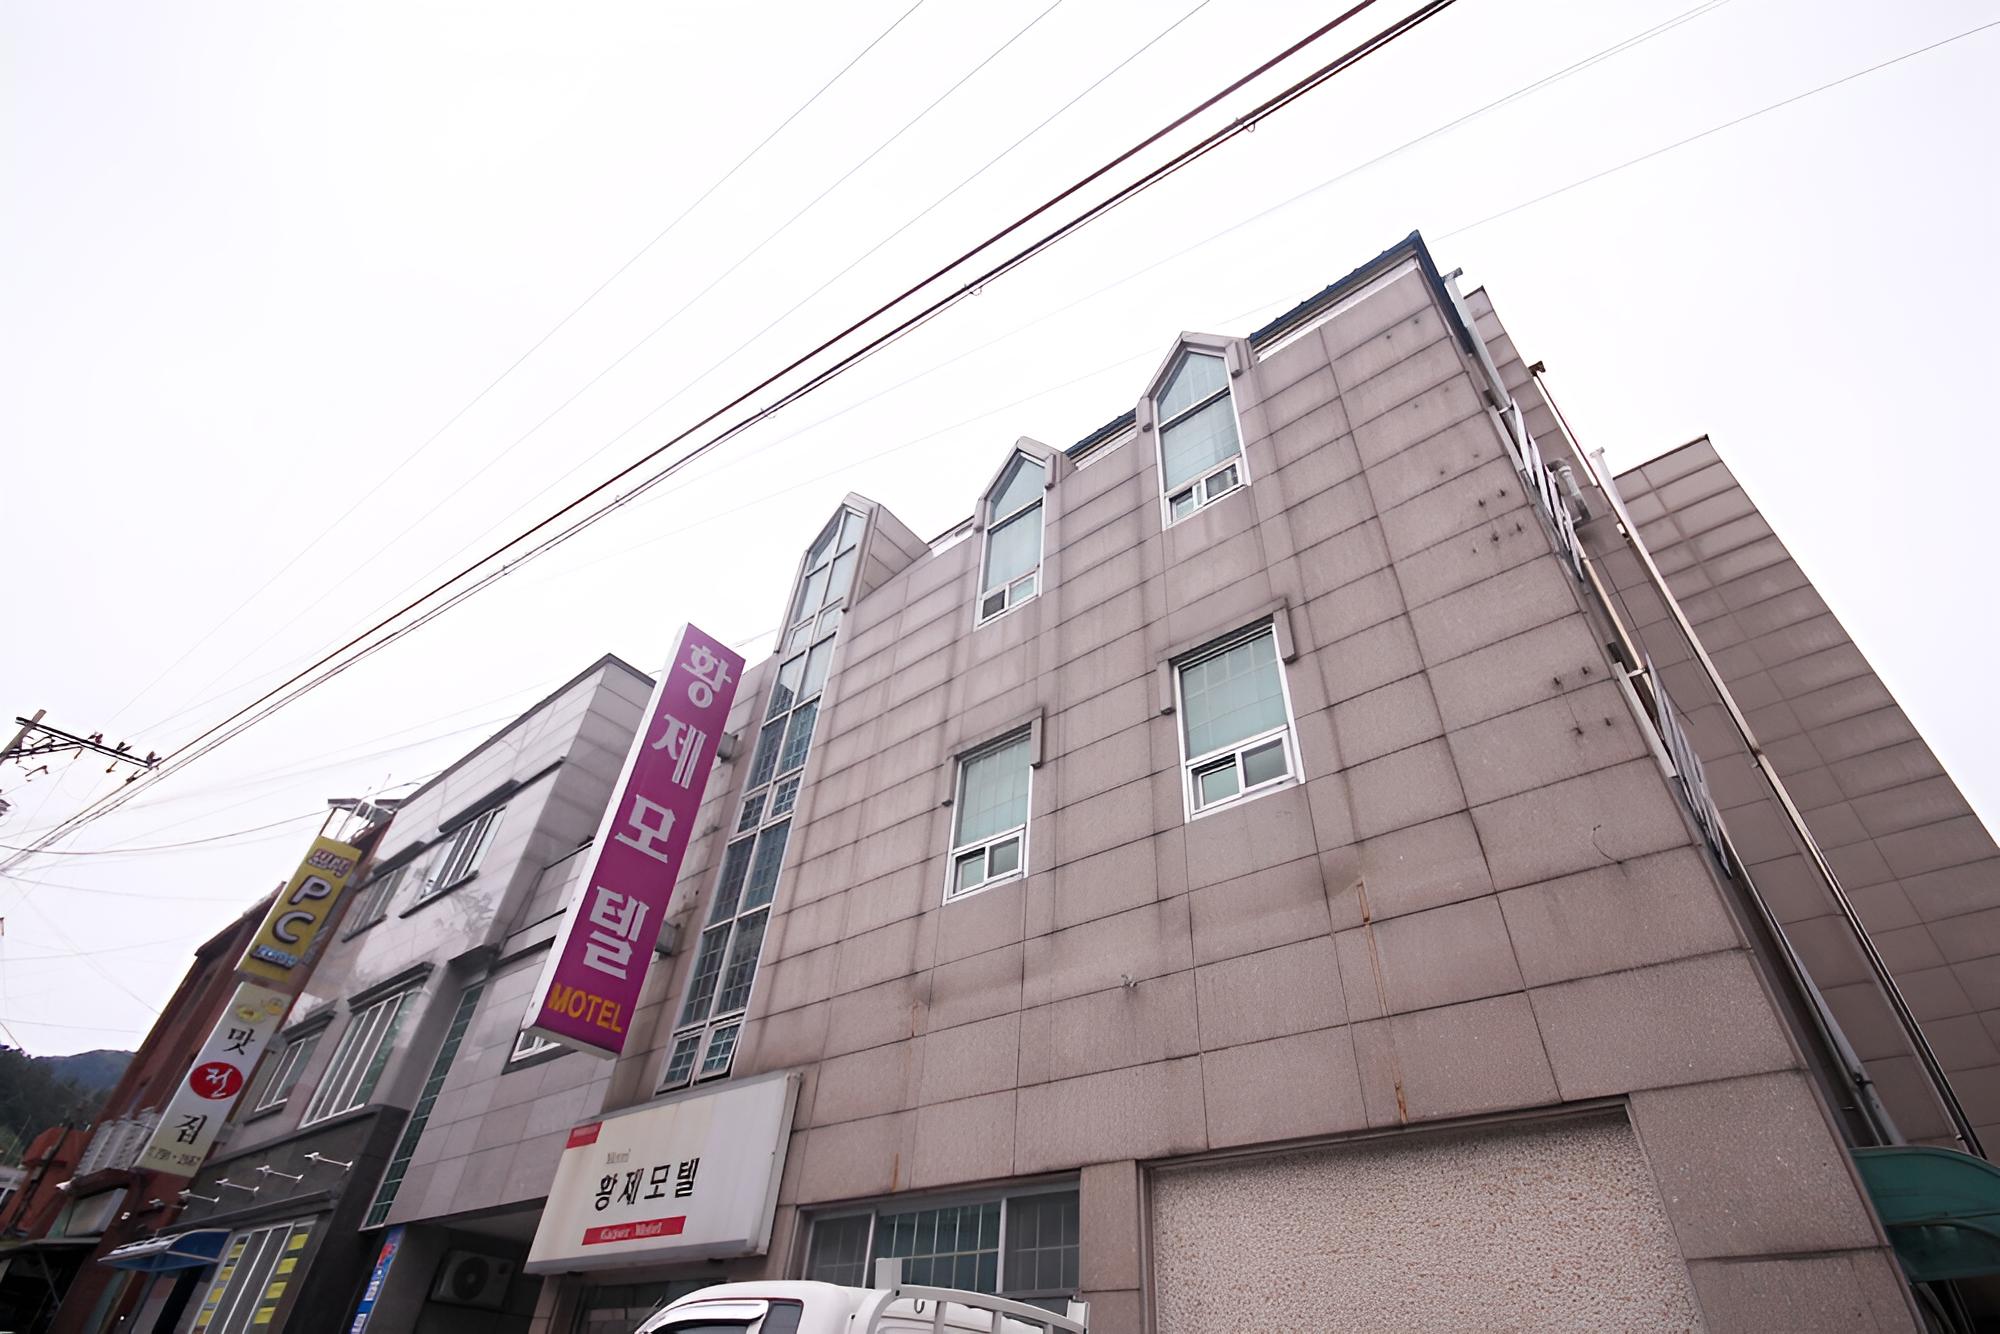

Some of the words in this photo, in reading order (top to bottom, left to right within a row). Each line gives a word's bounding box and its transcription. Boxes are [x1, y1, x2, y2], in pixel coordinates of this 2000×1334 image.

[583, 644, 733, 980] 황제모텔
[272, 874, 331, 944] PC
[548, 983, 622, 1032] MOTEL
[594, 1157, 700, 1212] 황제모텔
